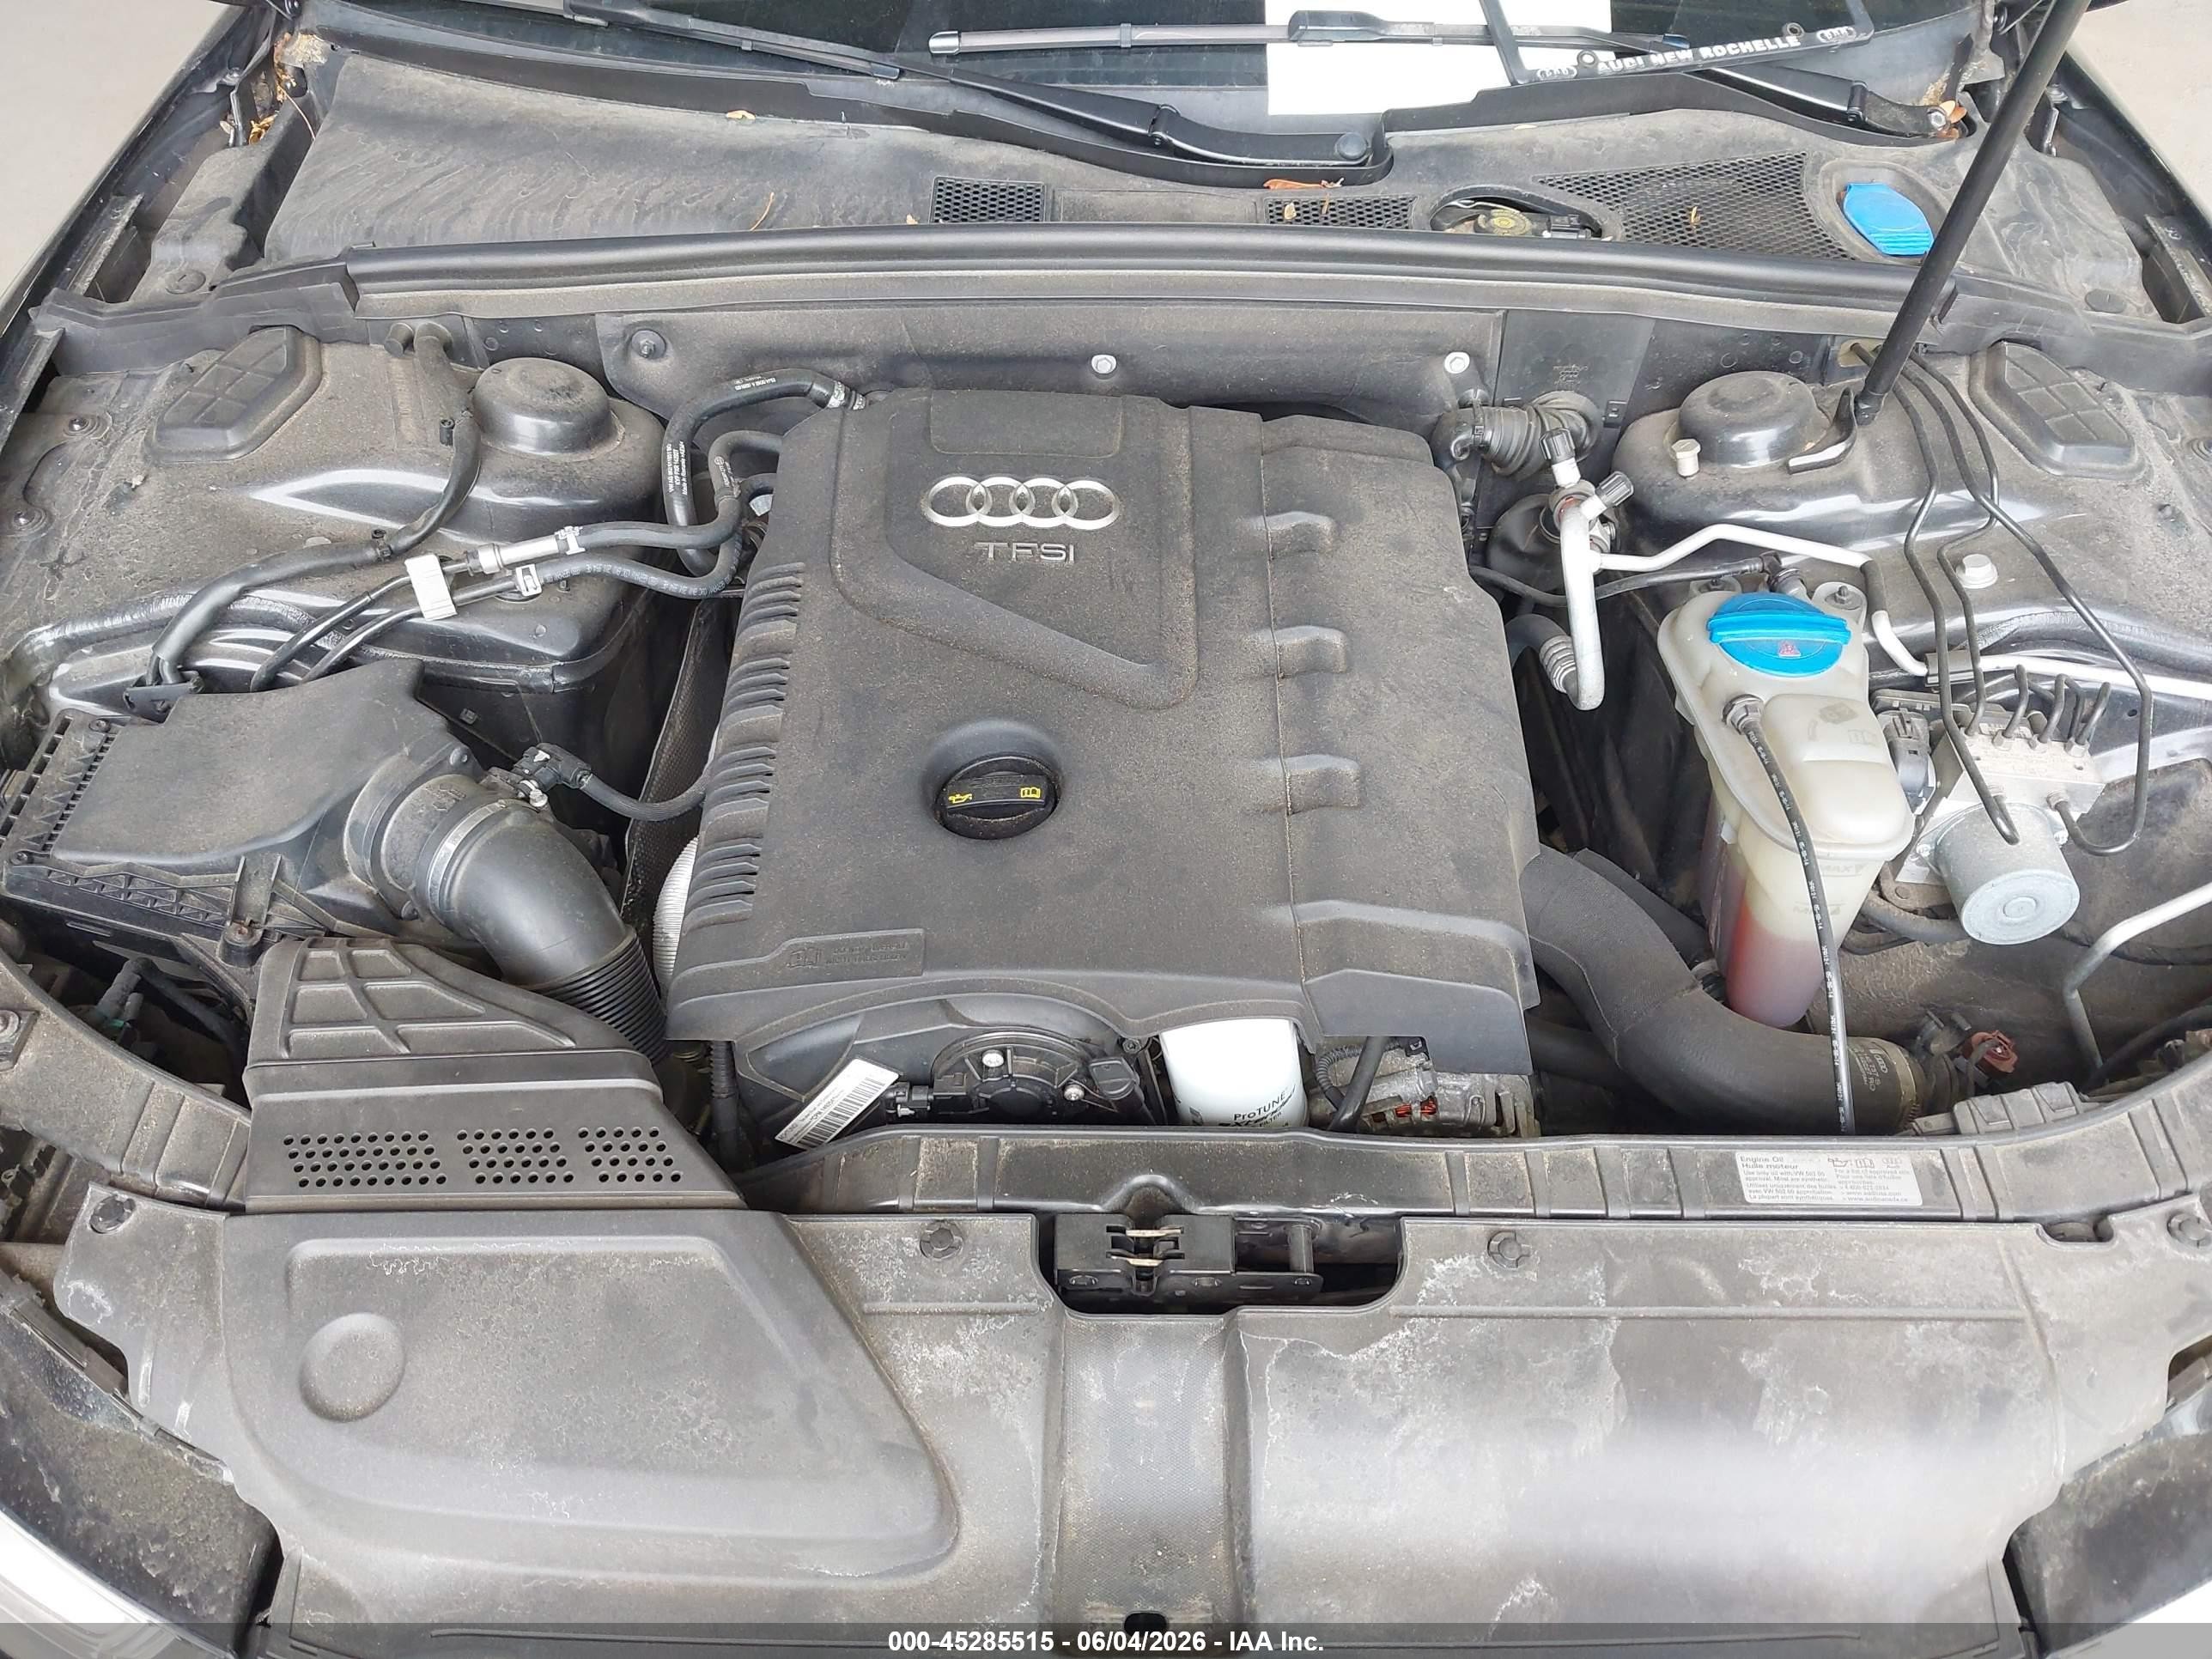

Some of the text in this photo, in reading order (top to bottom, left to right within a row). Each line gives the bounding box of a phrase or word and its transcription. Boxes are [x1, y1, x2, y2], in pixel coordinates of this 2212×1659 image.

[1597, 35, 1802, 75] AUDI NEW ROCHELLE
[974, 542, 1075, 562] TFSI
[1233, 1090, 1286, 1121] ProTUNE
[1740, 1156, 1770, 1164] Engine
